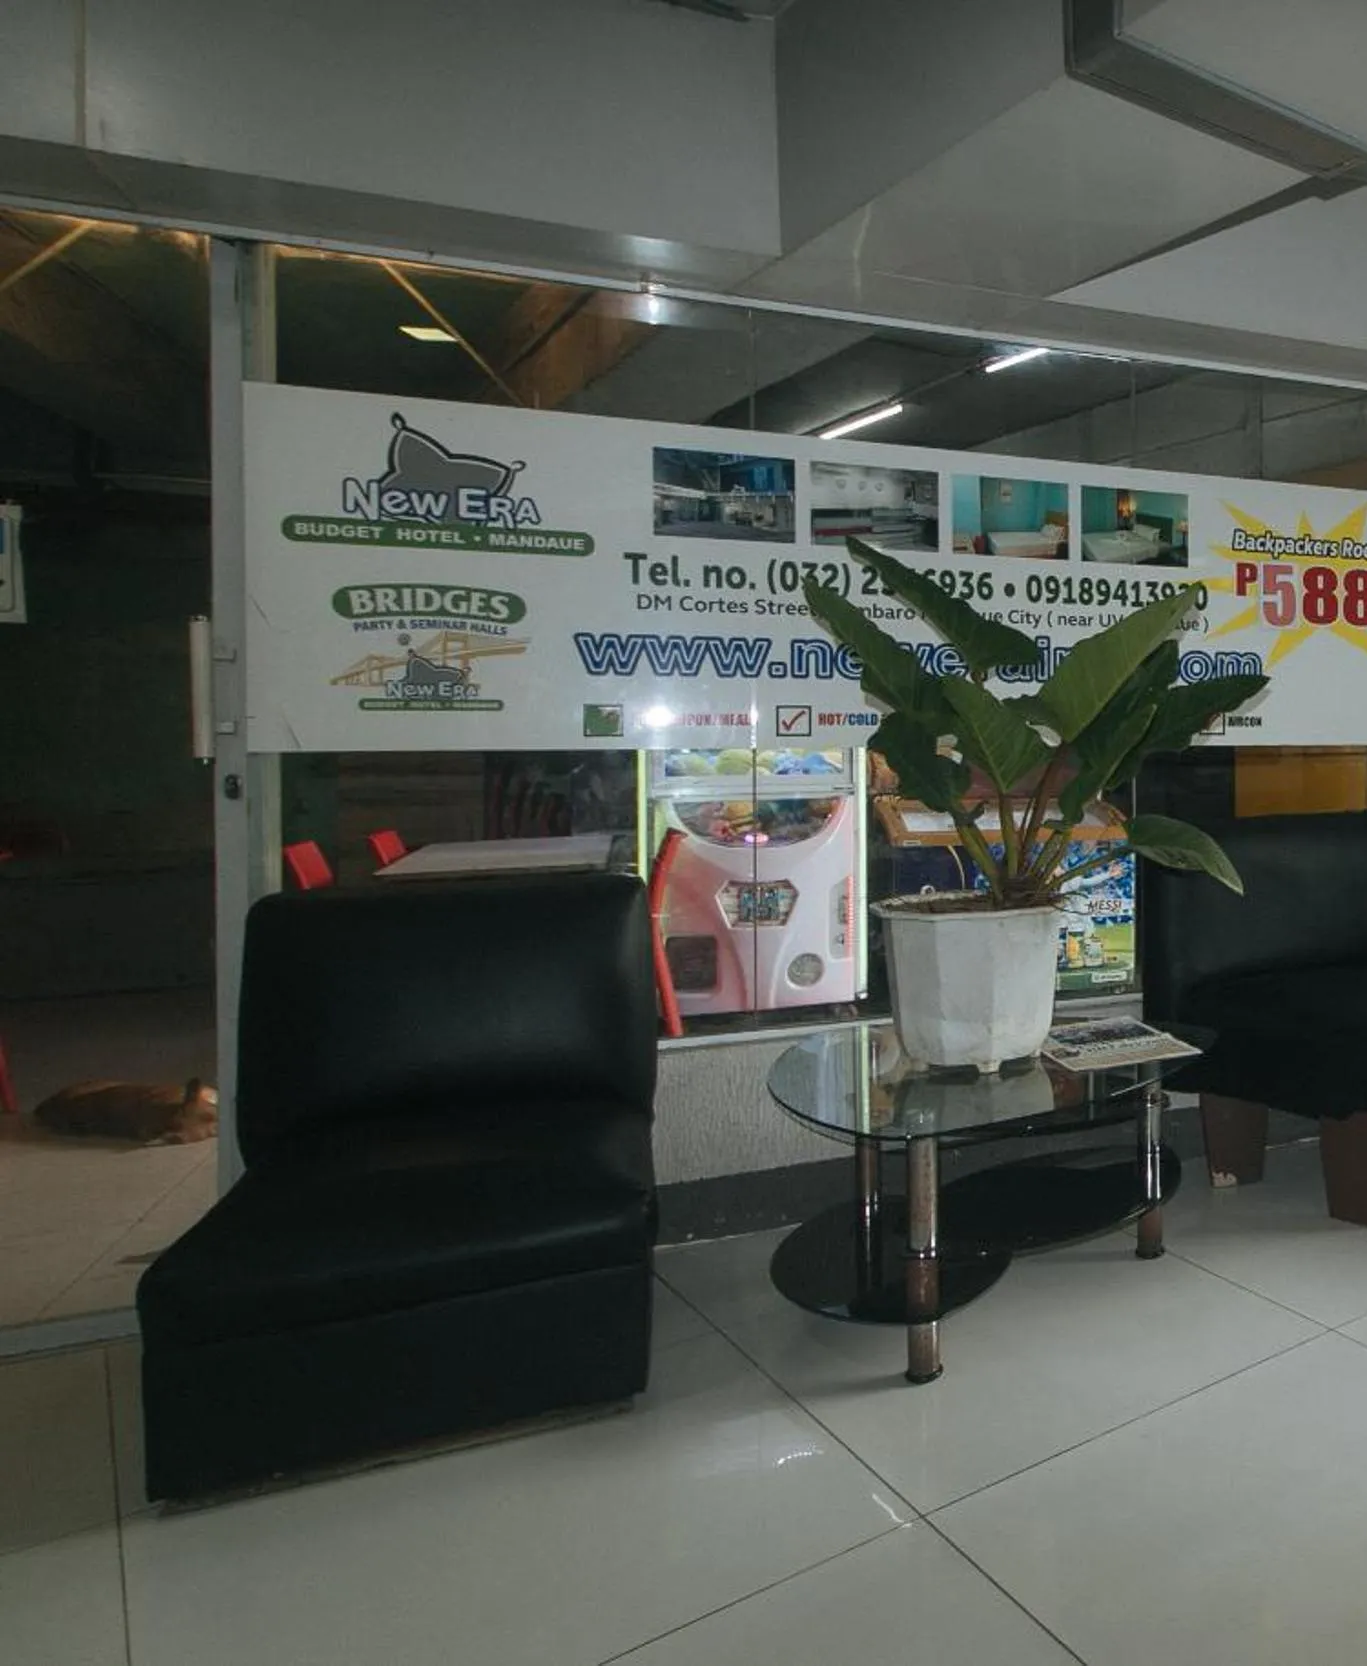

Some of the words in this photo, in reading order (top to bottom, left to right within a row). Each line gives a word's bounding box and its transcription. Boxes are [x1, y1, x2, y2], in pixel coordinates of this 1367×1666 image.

[343, 477, 449, 522] New
[458, 486, 541, 528] ERA
[294, 522, 384, 540] BUDGET
[396, 528, 466, 544] HOTEL
[489, 533, 586, 551] MANDAUE
[1232, 529, 1339, 560] Backpackers
[623, 552, 690, 588] Tel.
[703, 564, 756, 590] no.
[861, 566, 994, 600] 2936
[350, 587, 509, 619] BRIDGES
[637, 594, 672, 611] DM
[679, 596, 748, 613] Cortes
[754, 599, 813, 616] Stree
[1008, 610, 1041, 628] City
[353, 620, 393, 632] PARTY
[410, 619, 466, 631] SEMINAR
[470, 622, 508, 636] HALLS
[386, 680, 434, 698] New
[818, 712, 878, 726] HOT/COLD
[1087, 900, 1122, 913] MESSI
